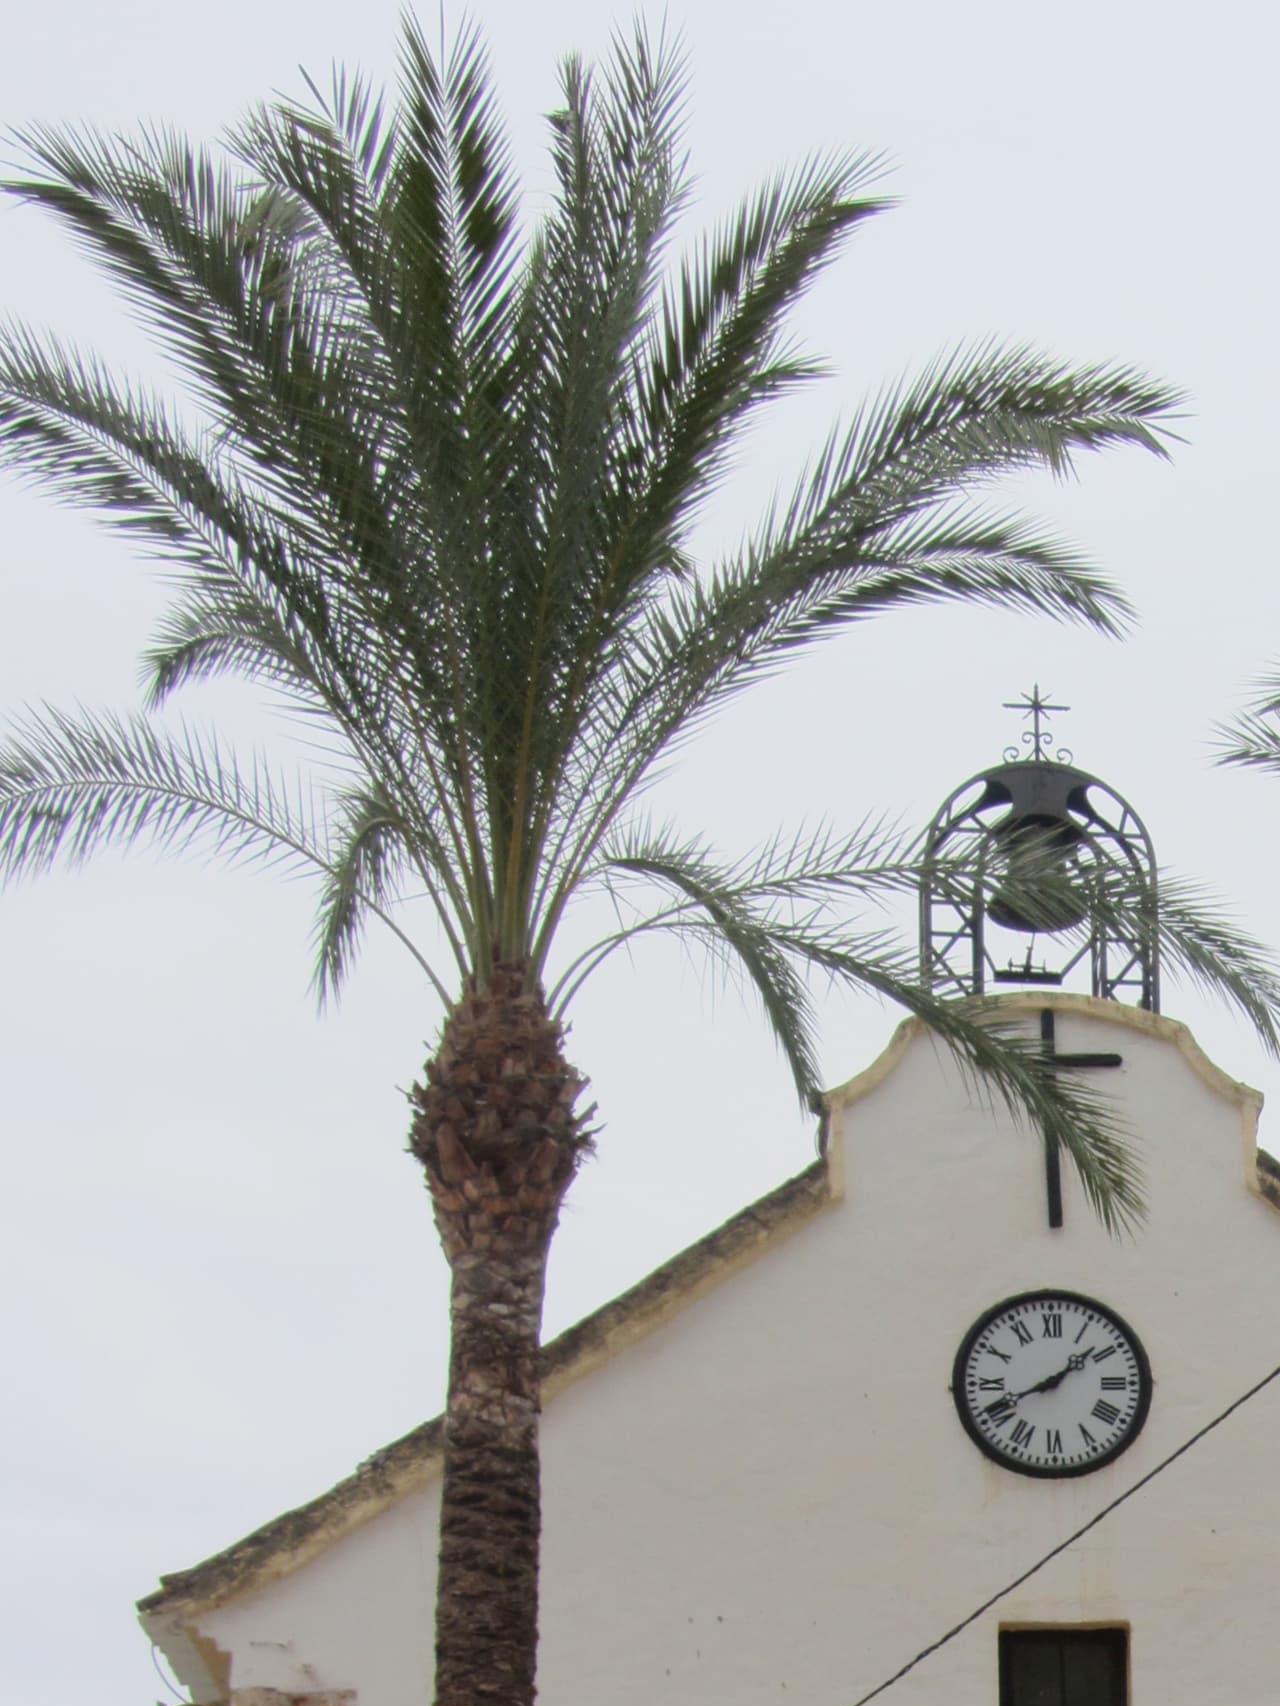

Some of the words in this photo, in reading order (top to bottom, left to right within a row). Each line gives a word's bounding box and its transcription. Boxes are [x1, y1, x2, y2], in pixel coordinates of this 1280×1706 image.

[1010, 1320, 1034, 1347] XI
[1042, 1313, 1062, 1338] XII
[1074, 1321, 1089, 1344] I
[986, 1345, 1012, 1365] X
[1092, 1345, 1117, 1364] II
[979, 1377, 1005, 1391] IX
[1101, 1377, 1126, 1391] III
[1009, 1418, 1036, 1449] VII
[1046, 1429, 1063, 1454] VI
[1078, 1423, 1096, 1447] V
